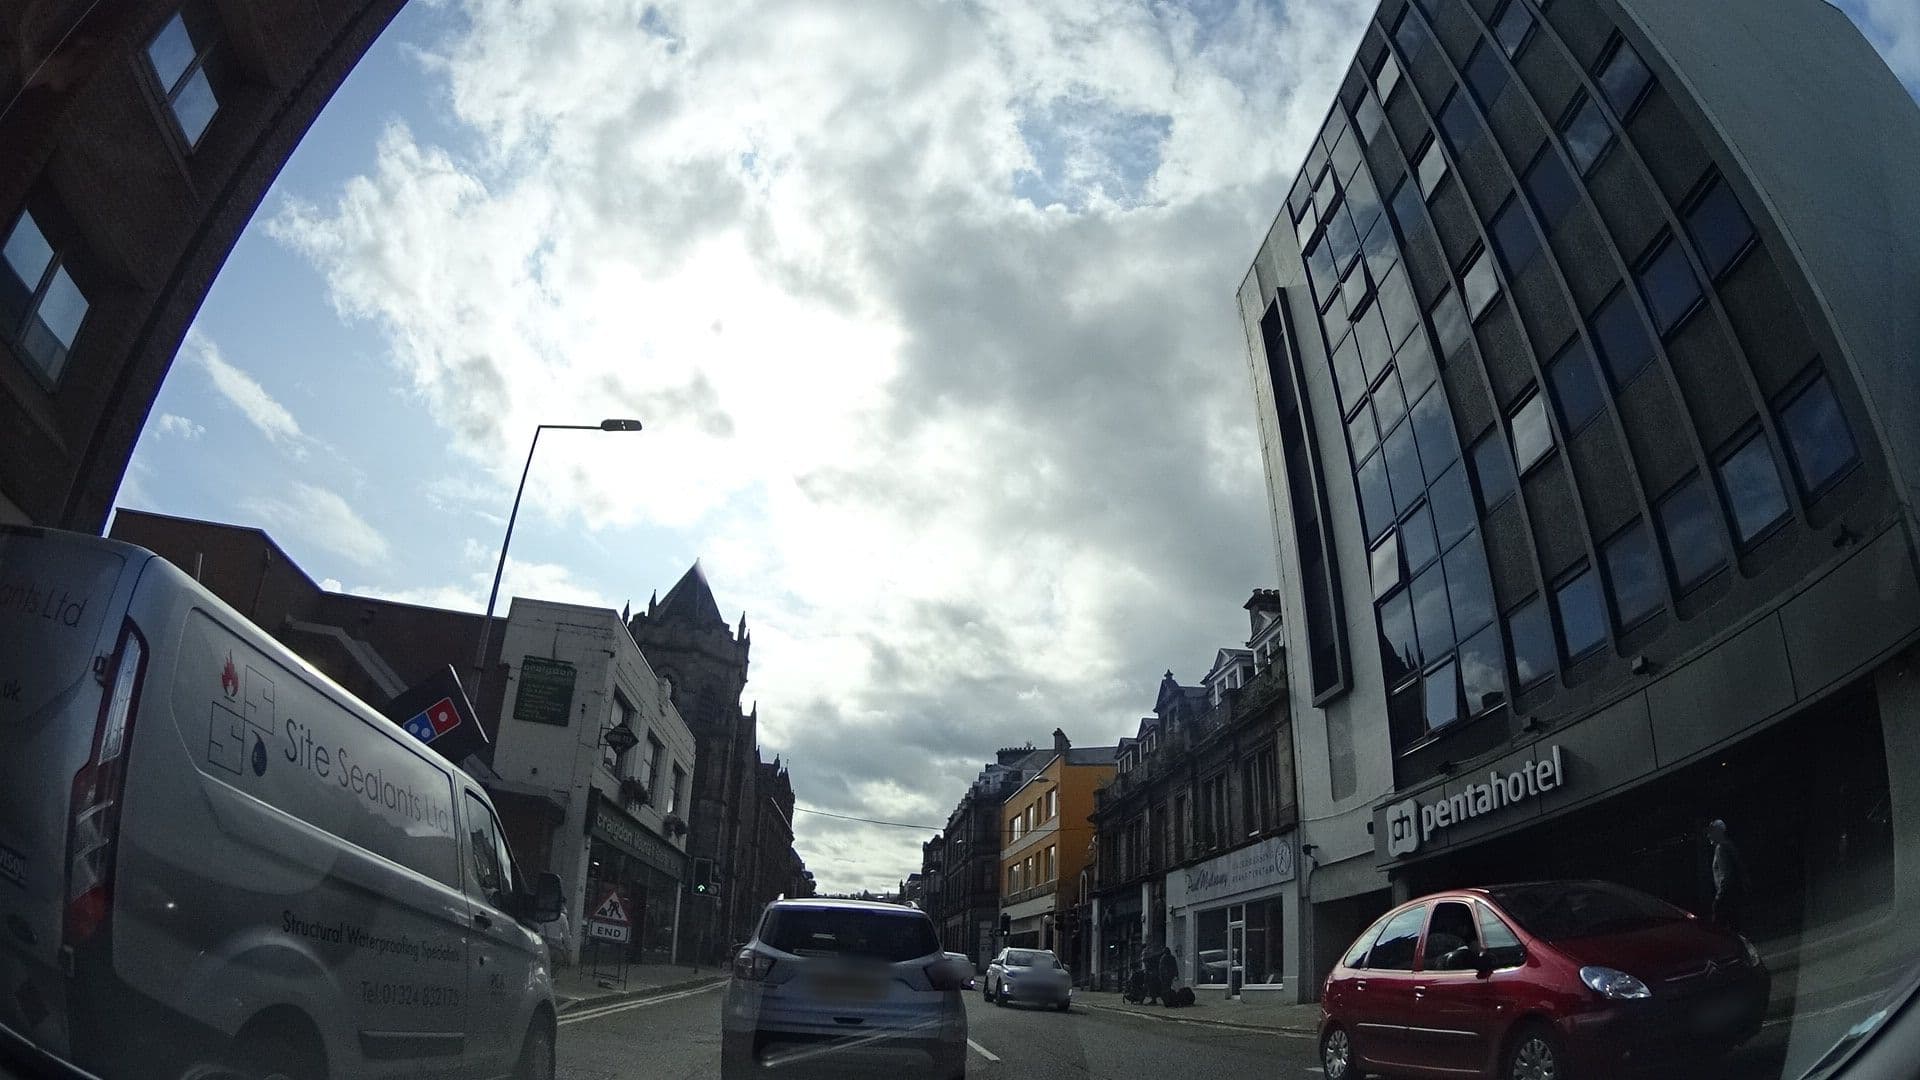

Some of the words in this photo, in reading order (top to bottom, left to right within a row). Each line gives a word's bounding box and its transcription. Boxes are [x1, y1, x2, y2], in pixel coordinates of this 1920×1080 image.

[42, 588, 88, 628] Ltd
[285, 718, 330, 778] Site
[338, 747, 422, 822] Sealants
[424, 792, 450, 833] Ltd
[1420, 745, 1564, 842] pentahotel
[282, 910, 343, 943] Structural
[347, 926, 418, 961] Waterproofing
[597, 926, 621, 938] END
